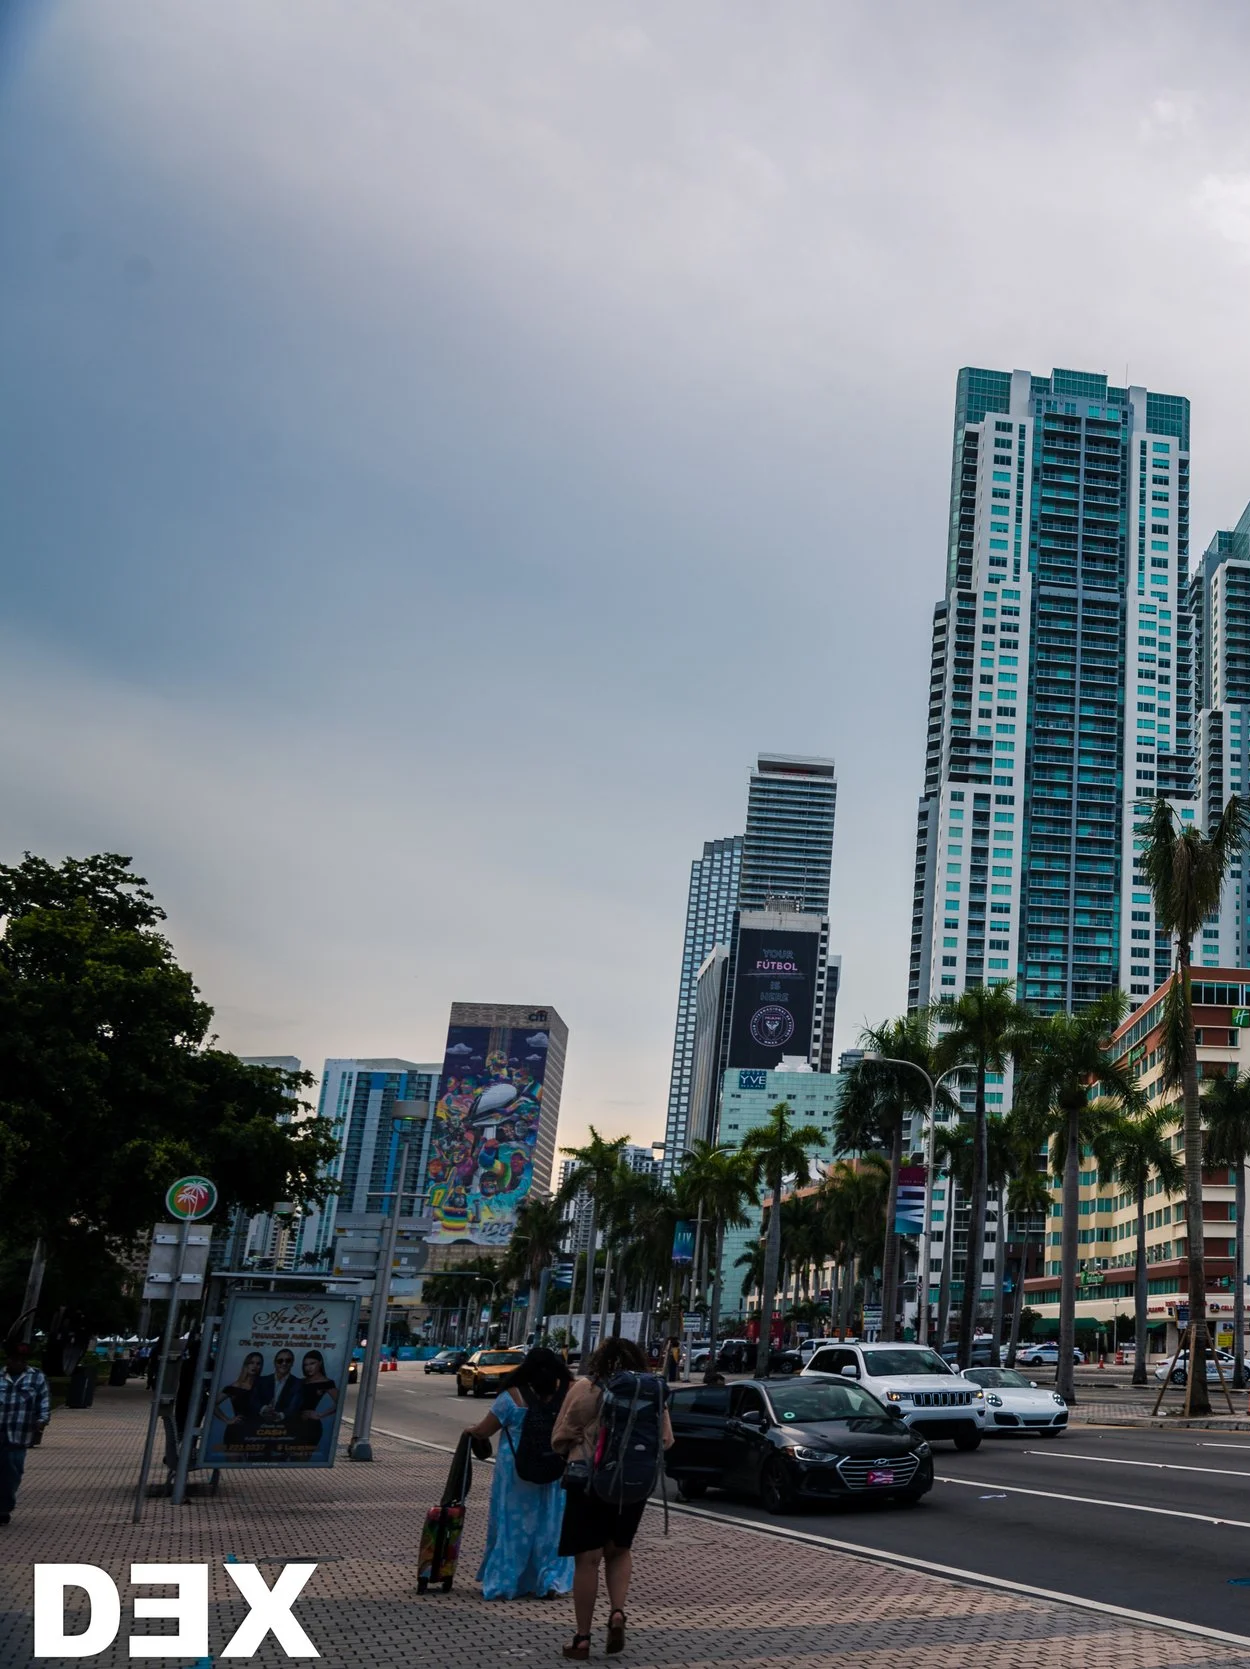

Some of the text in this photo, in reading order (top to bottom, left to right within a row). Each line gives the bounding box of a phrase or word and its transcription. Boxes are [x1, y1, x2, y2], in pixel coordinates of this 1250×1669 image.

[763, 949, 794, 959] YOUR
[756, 959, 798, 971] FÚTBOL
[740, 1075, 766, 1084] YVE
